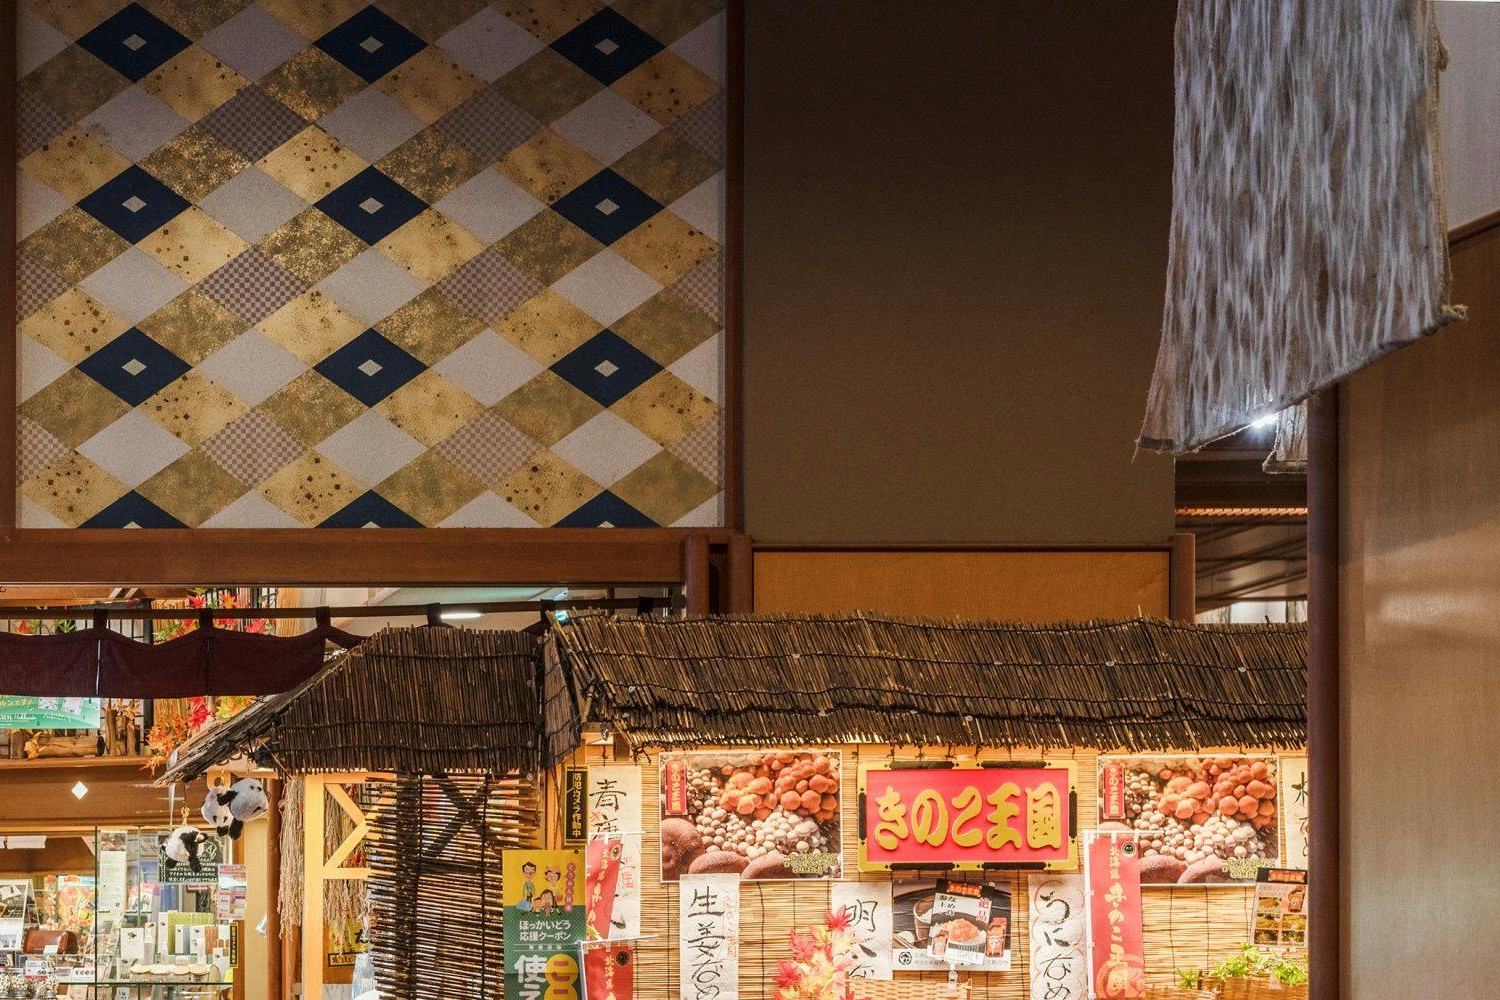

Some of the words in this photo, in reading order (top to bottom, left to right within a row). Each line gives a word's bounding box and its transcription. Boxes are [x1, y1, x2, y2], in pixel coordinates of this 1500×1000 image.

[874, 782, 1062, 850] きのこ王国
[519, 921, 571, 930] ほっかいどう
[520, 931, 571, 941] 応援クーポン
